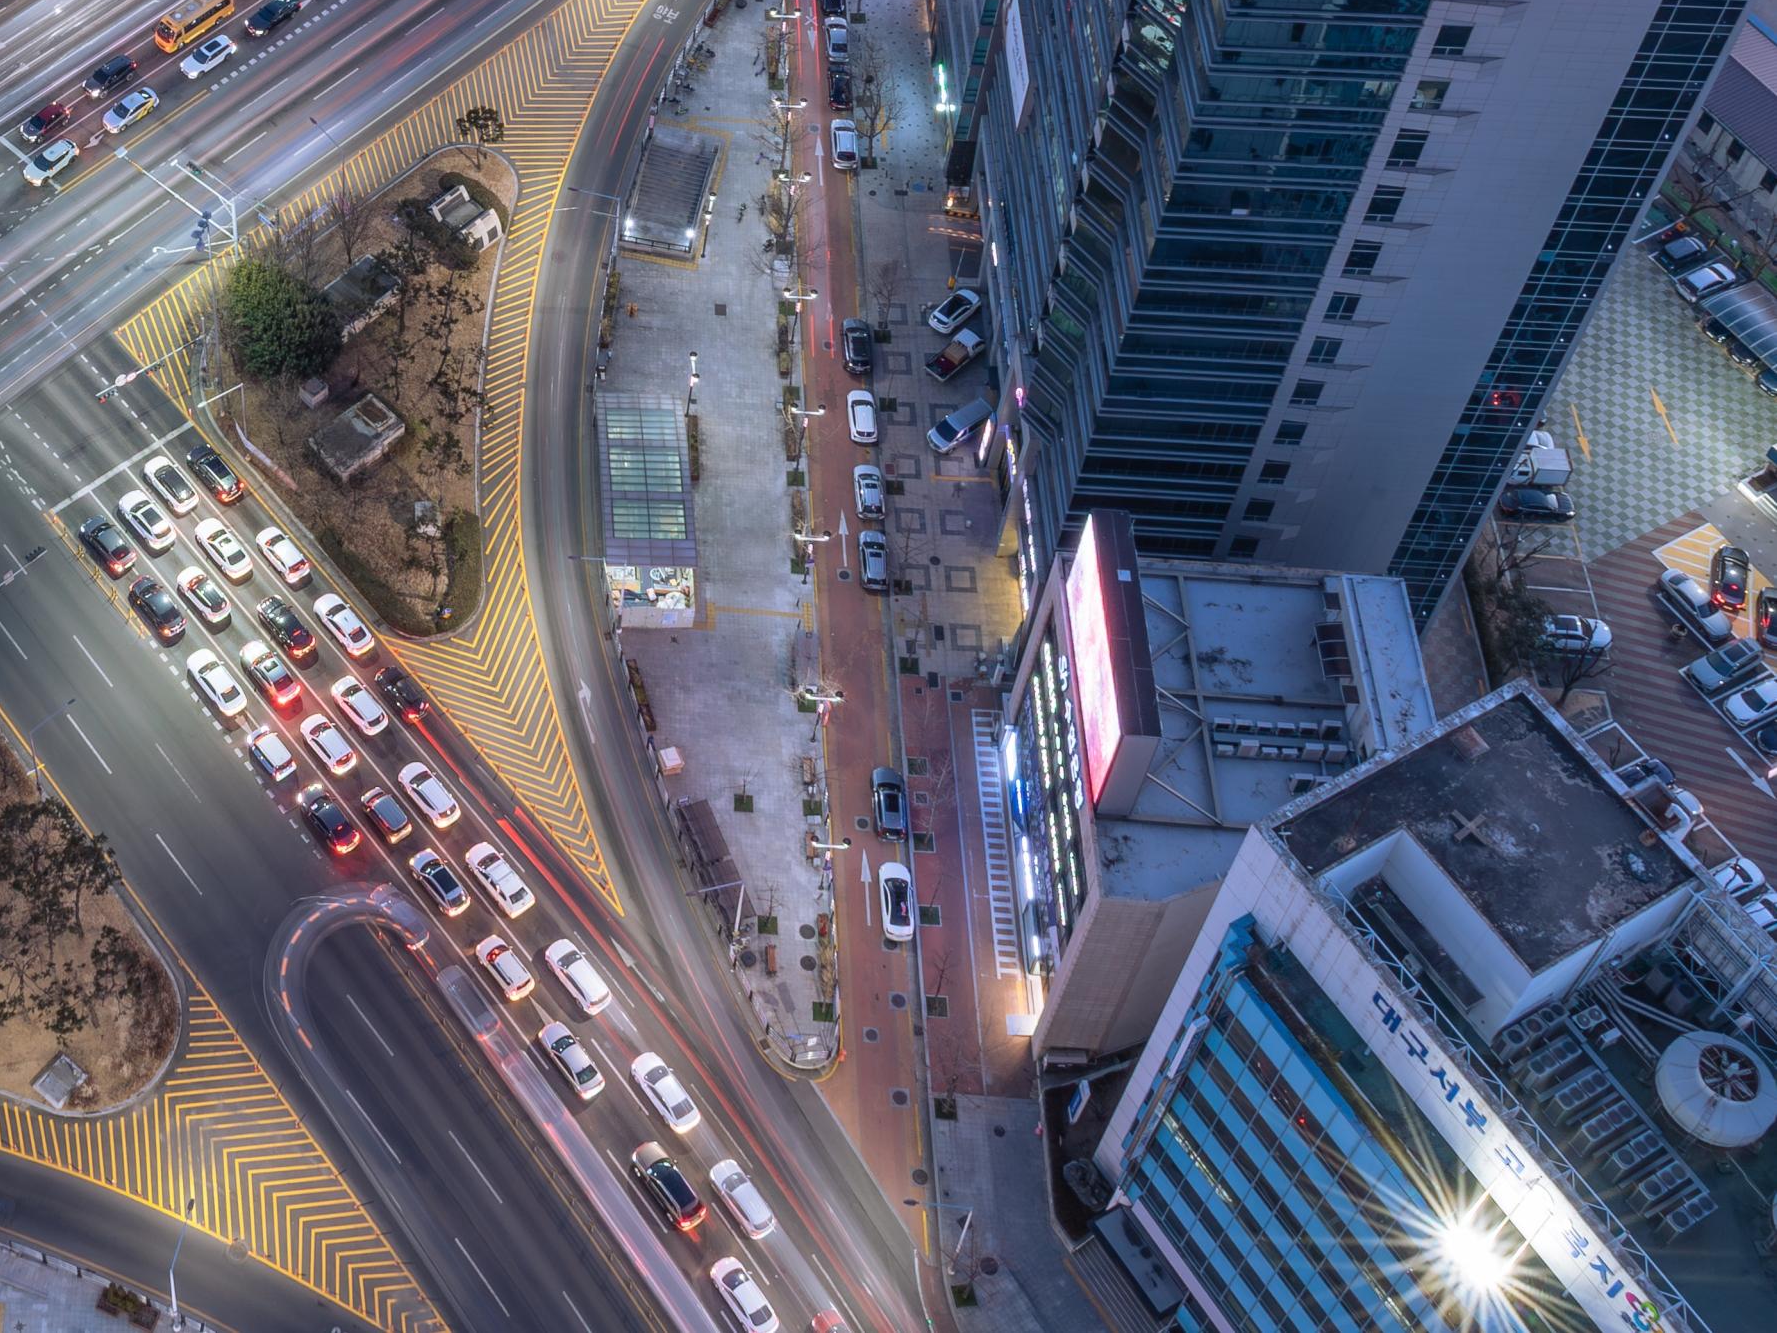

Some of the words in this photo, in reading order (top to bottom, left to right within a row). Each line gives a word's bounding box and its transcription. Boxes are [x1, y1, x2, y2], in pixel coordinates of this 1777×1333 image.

[653, 5, 679, 25] 양보
[1373, 991, 1487, 1135] 대구서부
[1494, 1144, 1624, 1298] 고복지
